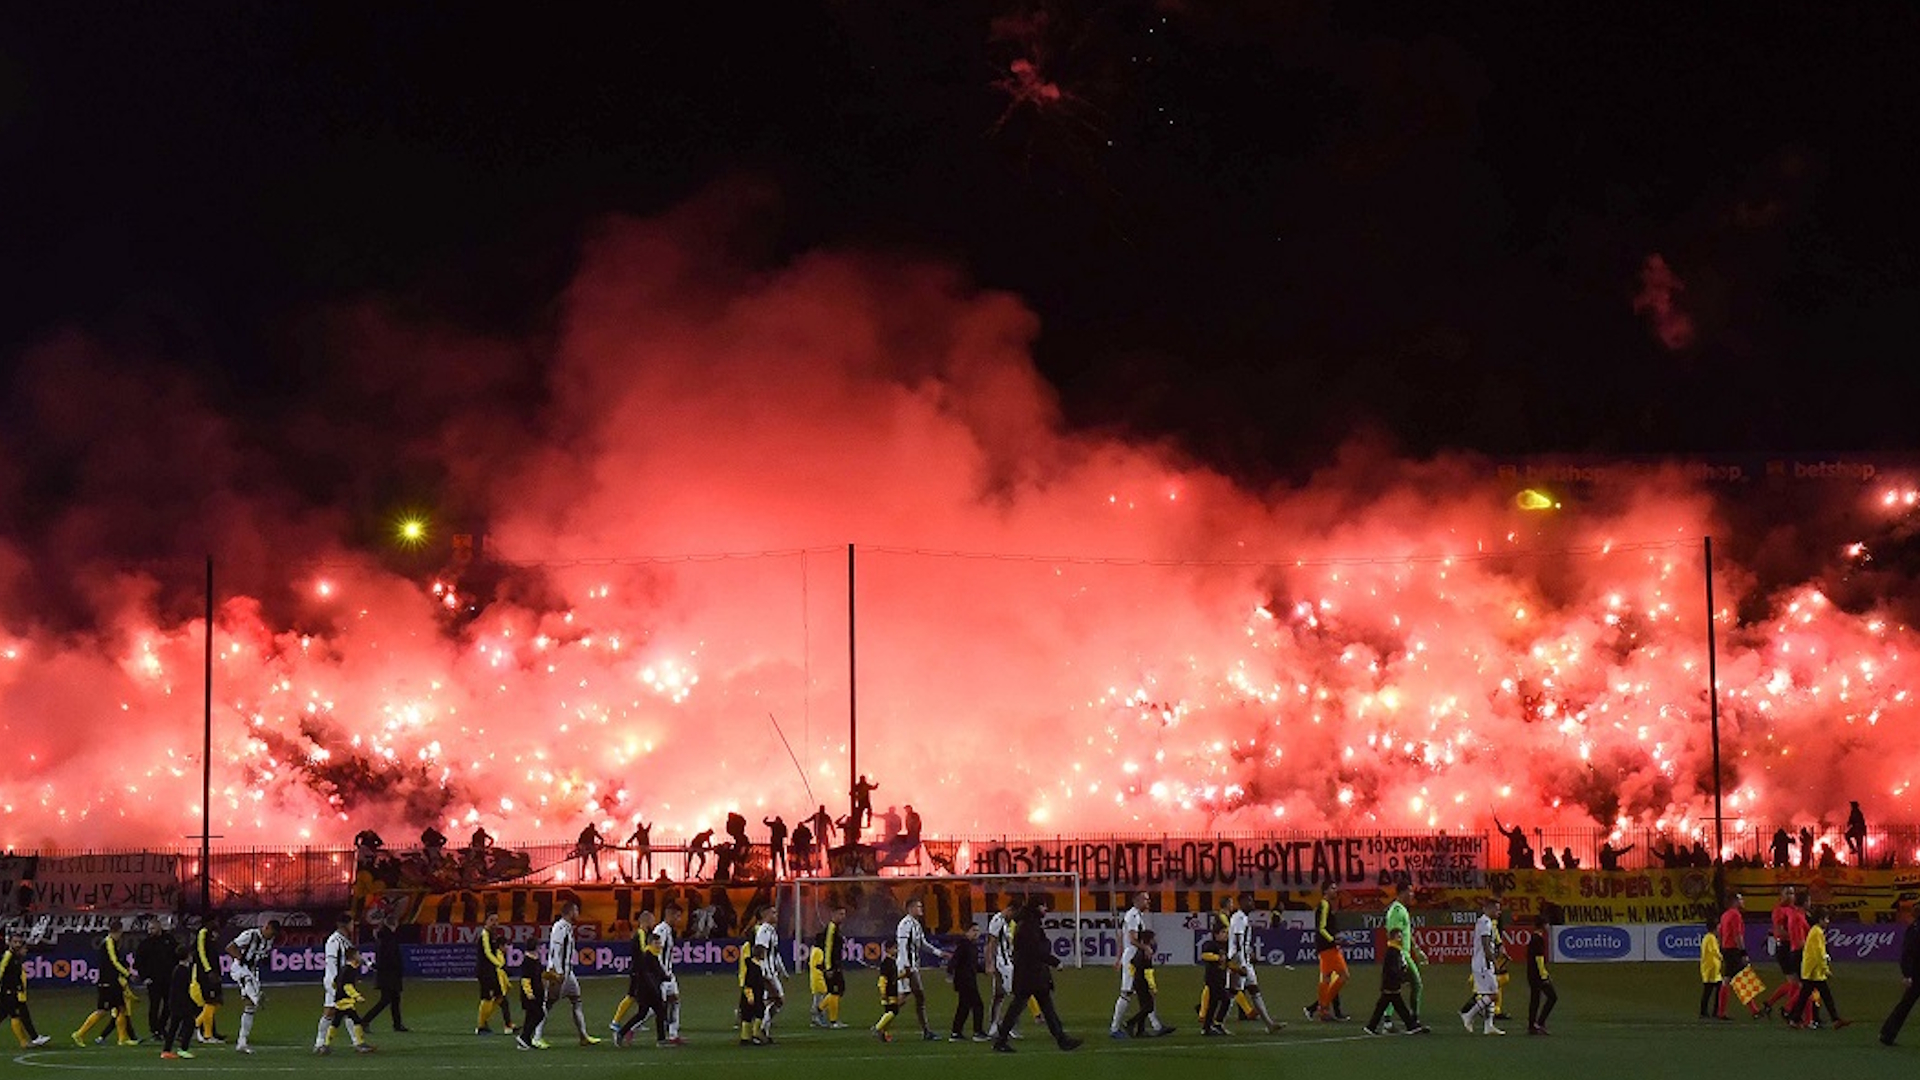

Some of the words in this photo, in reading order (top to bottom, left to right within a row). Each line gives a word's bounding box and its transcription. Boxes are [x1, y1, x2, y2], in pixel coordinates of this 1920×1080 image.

[1579, 874, 1654, 898] SUPER
[1660, 876, 1674, 898] 3
[456, 924, 597, 944] MORS
[1565, 934, 1621, 949] Condito
[1664, 934, 1702, 949] Cond
[671, 941, 742, 964] etsho
